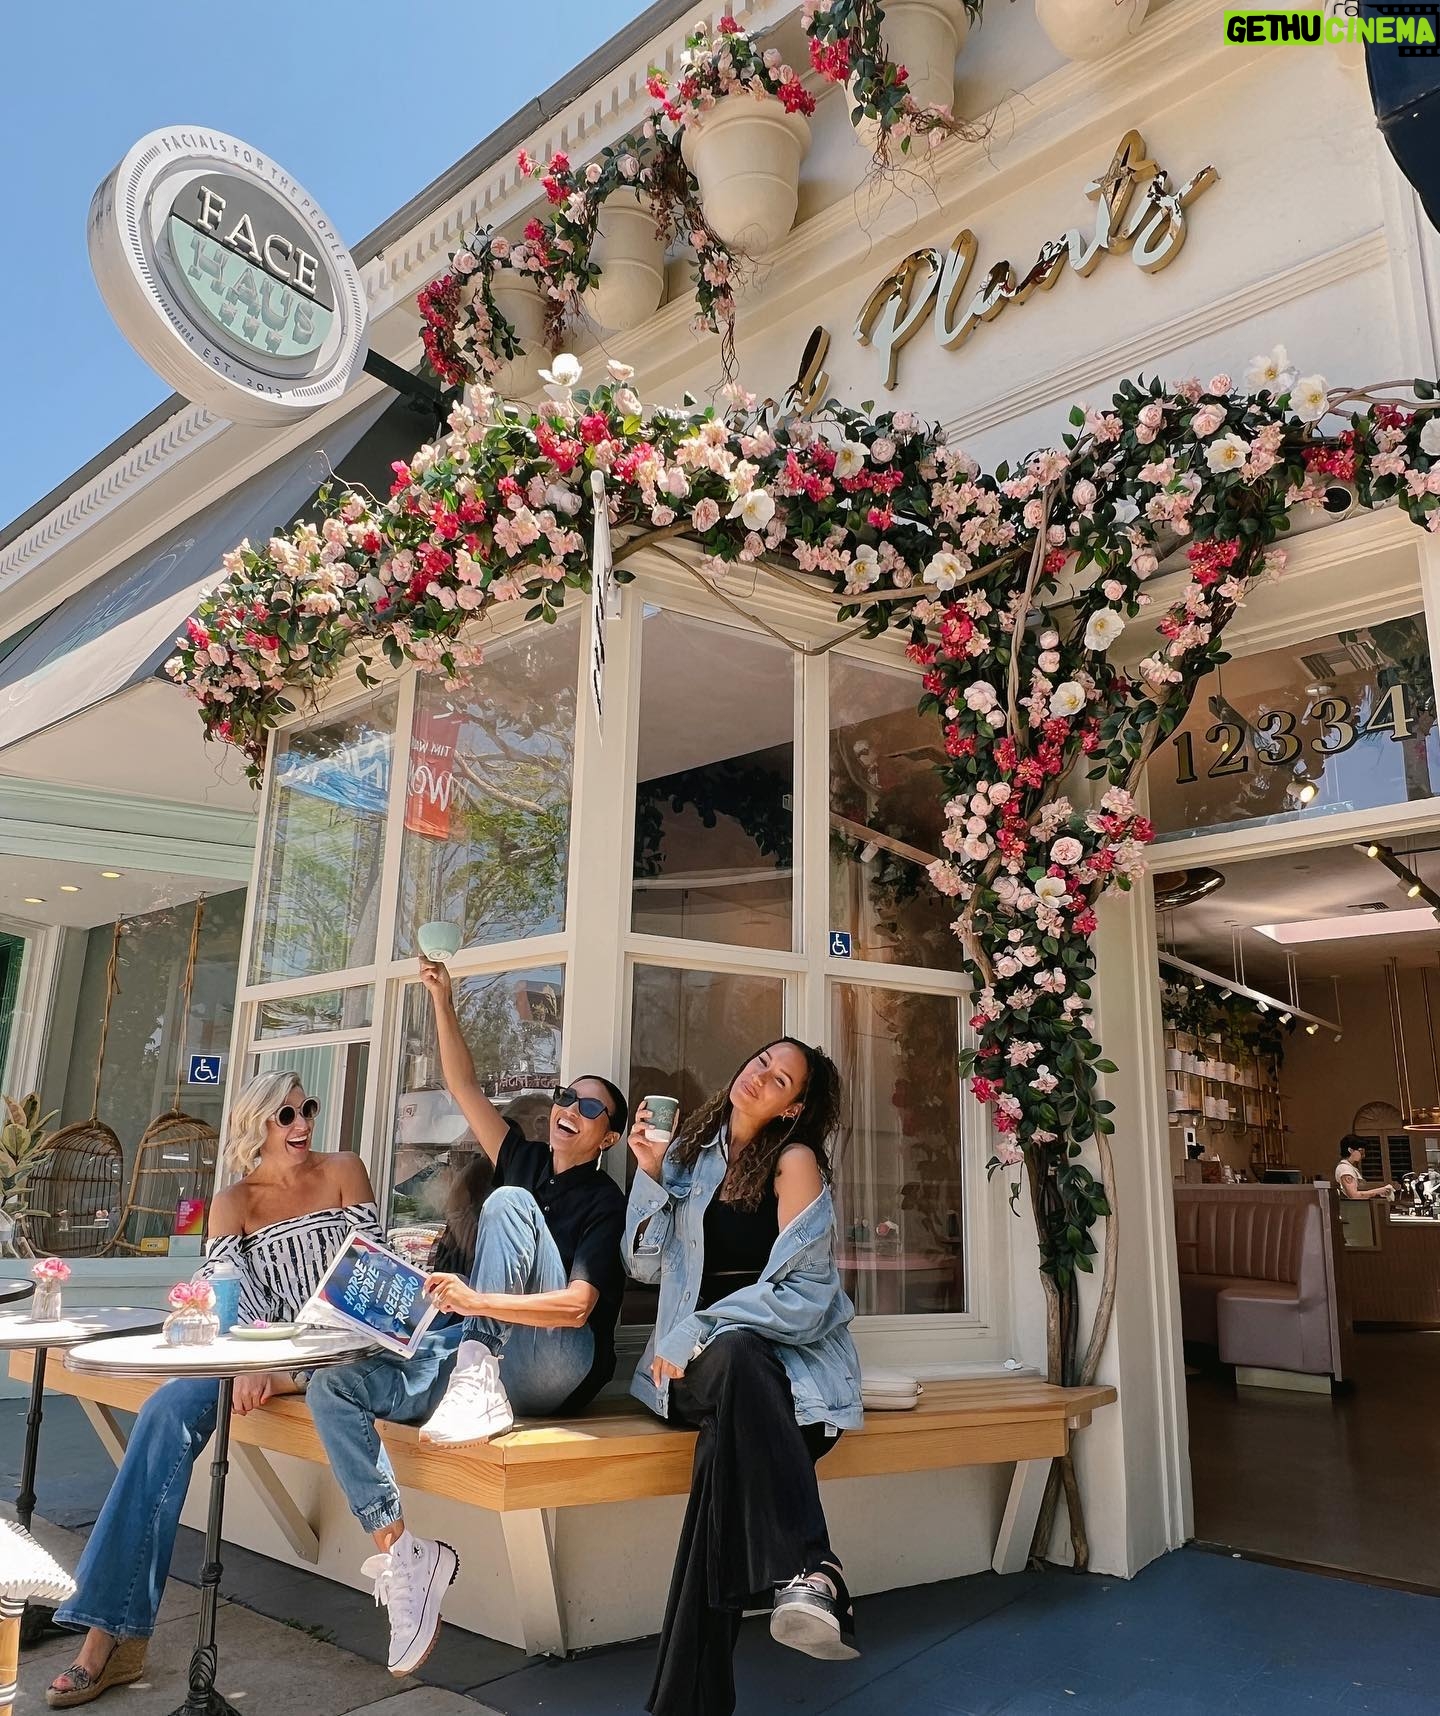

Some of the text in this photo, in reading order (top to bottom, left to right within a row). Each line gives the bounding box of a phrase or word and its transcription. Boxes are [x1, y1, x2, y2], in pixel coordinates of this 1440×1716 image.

[161, 134, 346, 261] FACIALS FOR THE PEOPLE
[197, 185, 319, 298] FACE
[853, 128, 1222, 392] Plants
[187, 233, 315, 346] HAUS
[202, 347, 283, 399] EST. 2013
[1172, 684, 1418, 784] 12334
[344, 1259, 367, 1305] HORSE
[353, 1266, 380, 1316] BARBIE
[383, 1273, 406, 1316] GEENA
[394, 1275, 419, 1325] ROCERO
